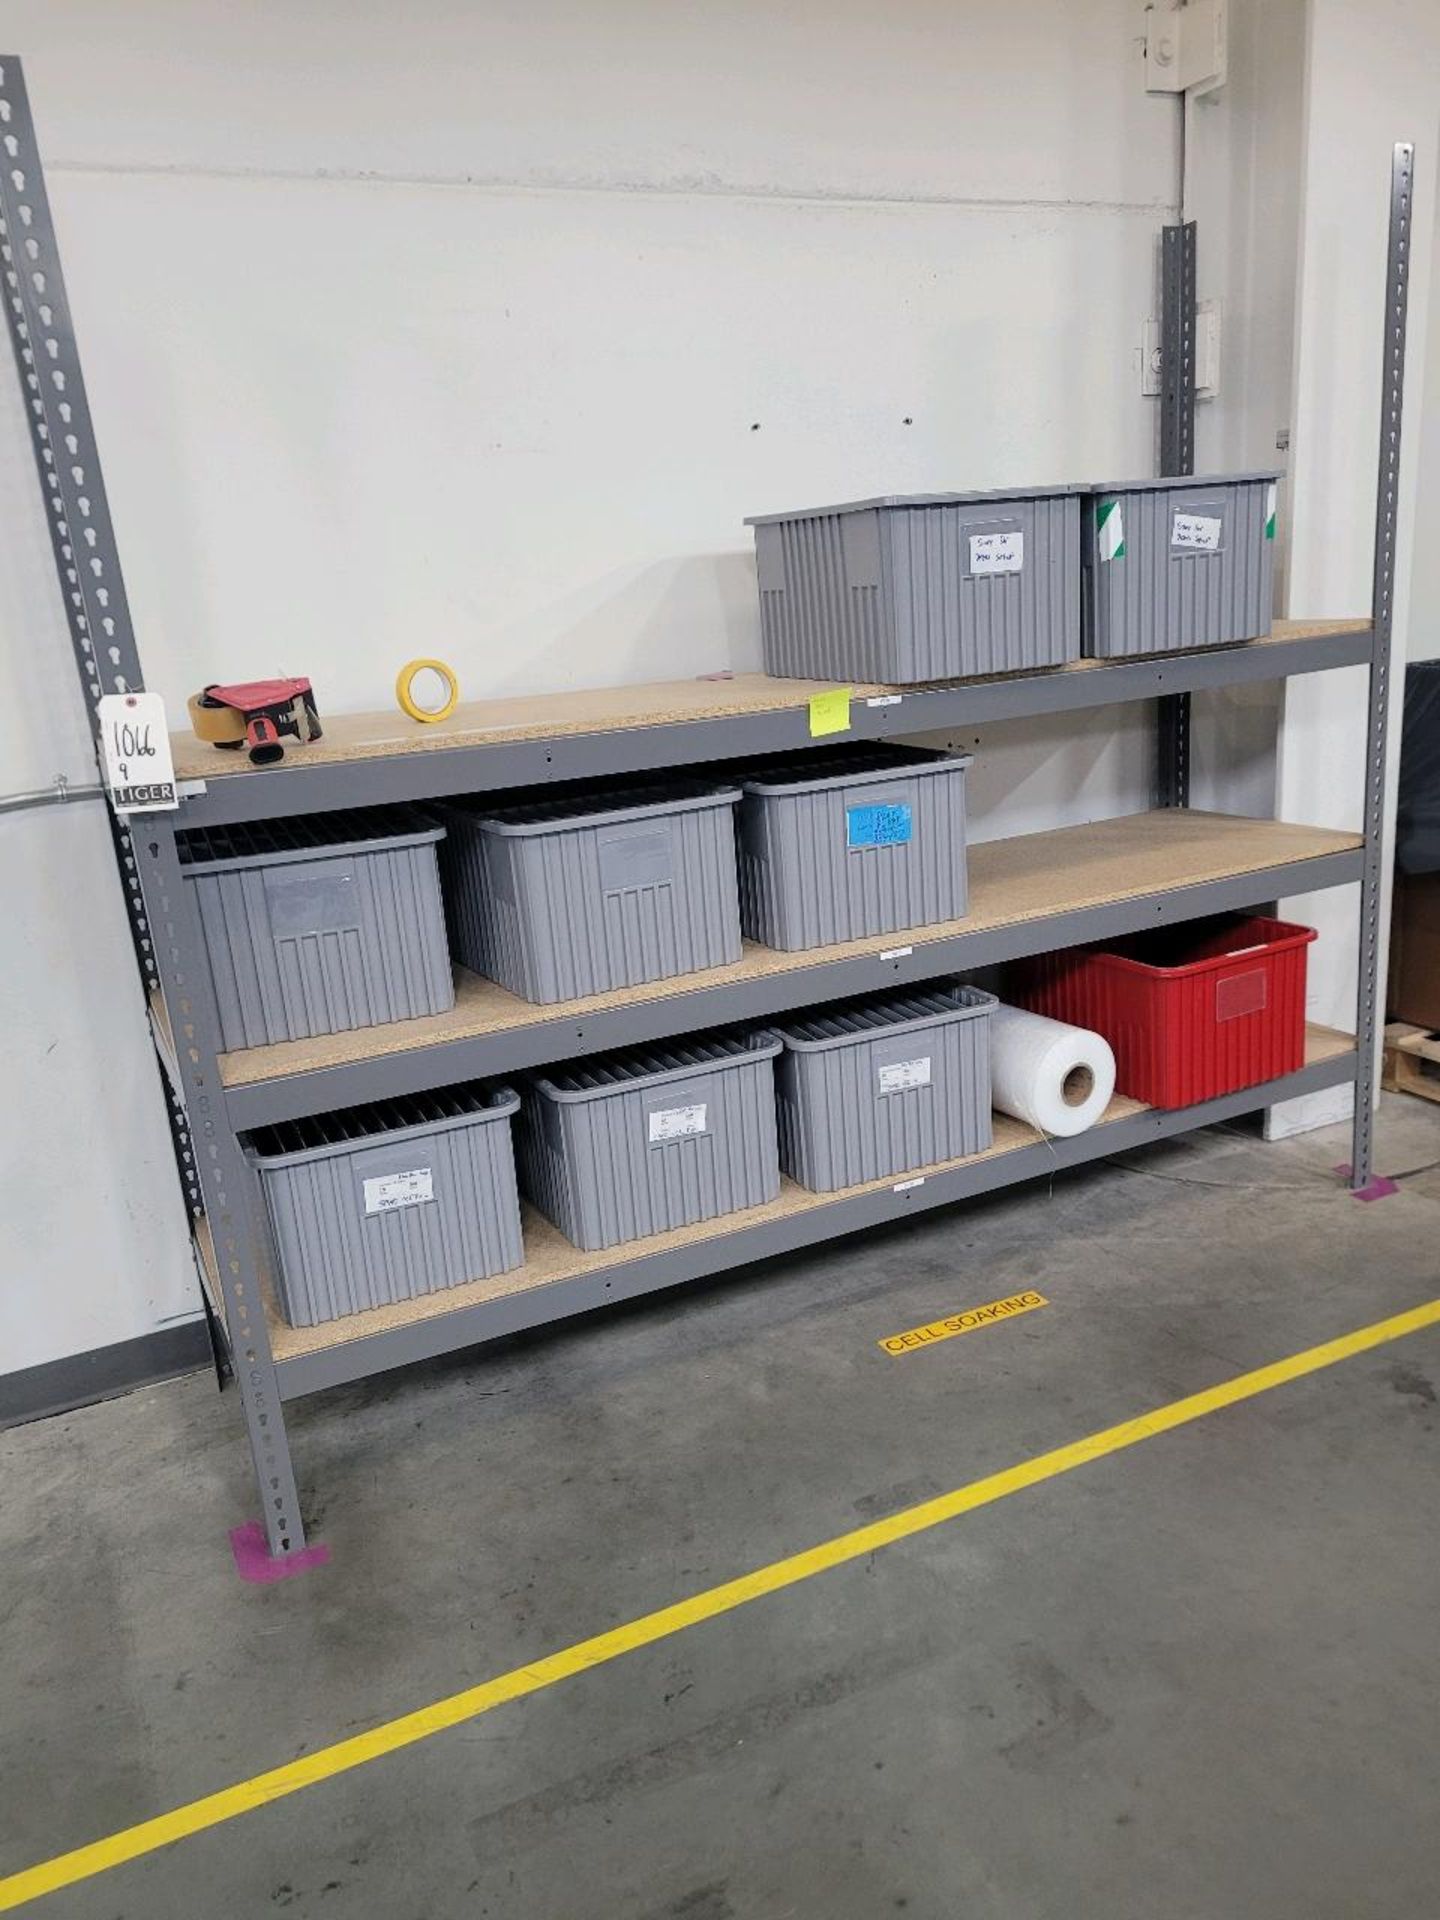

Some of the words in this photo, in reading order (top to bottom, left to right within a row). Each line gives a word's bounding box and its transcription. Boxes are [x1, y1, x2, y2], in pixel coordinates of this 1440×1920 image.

[114, 720, 156, 757] 1066
[119, 762, 129, 781] 9
[115, 784, 174, 803] TIGER
[885, 1327, 944, 1351] CELL
[944, 1293, 1041, 1332] SOAKING
